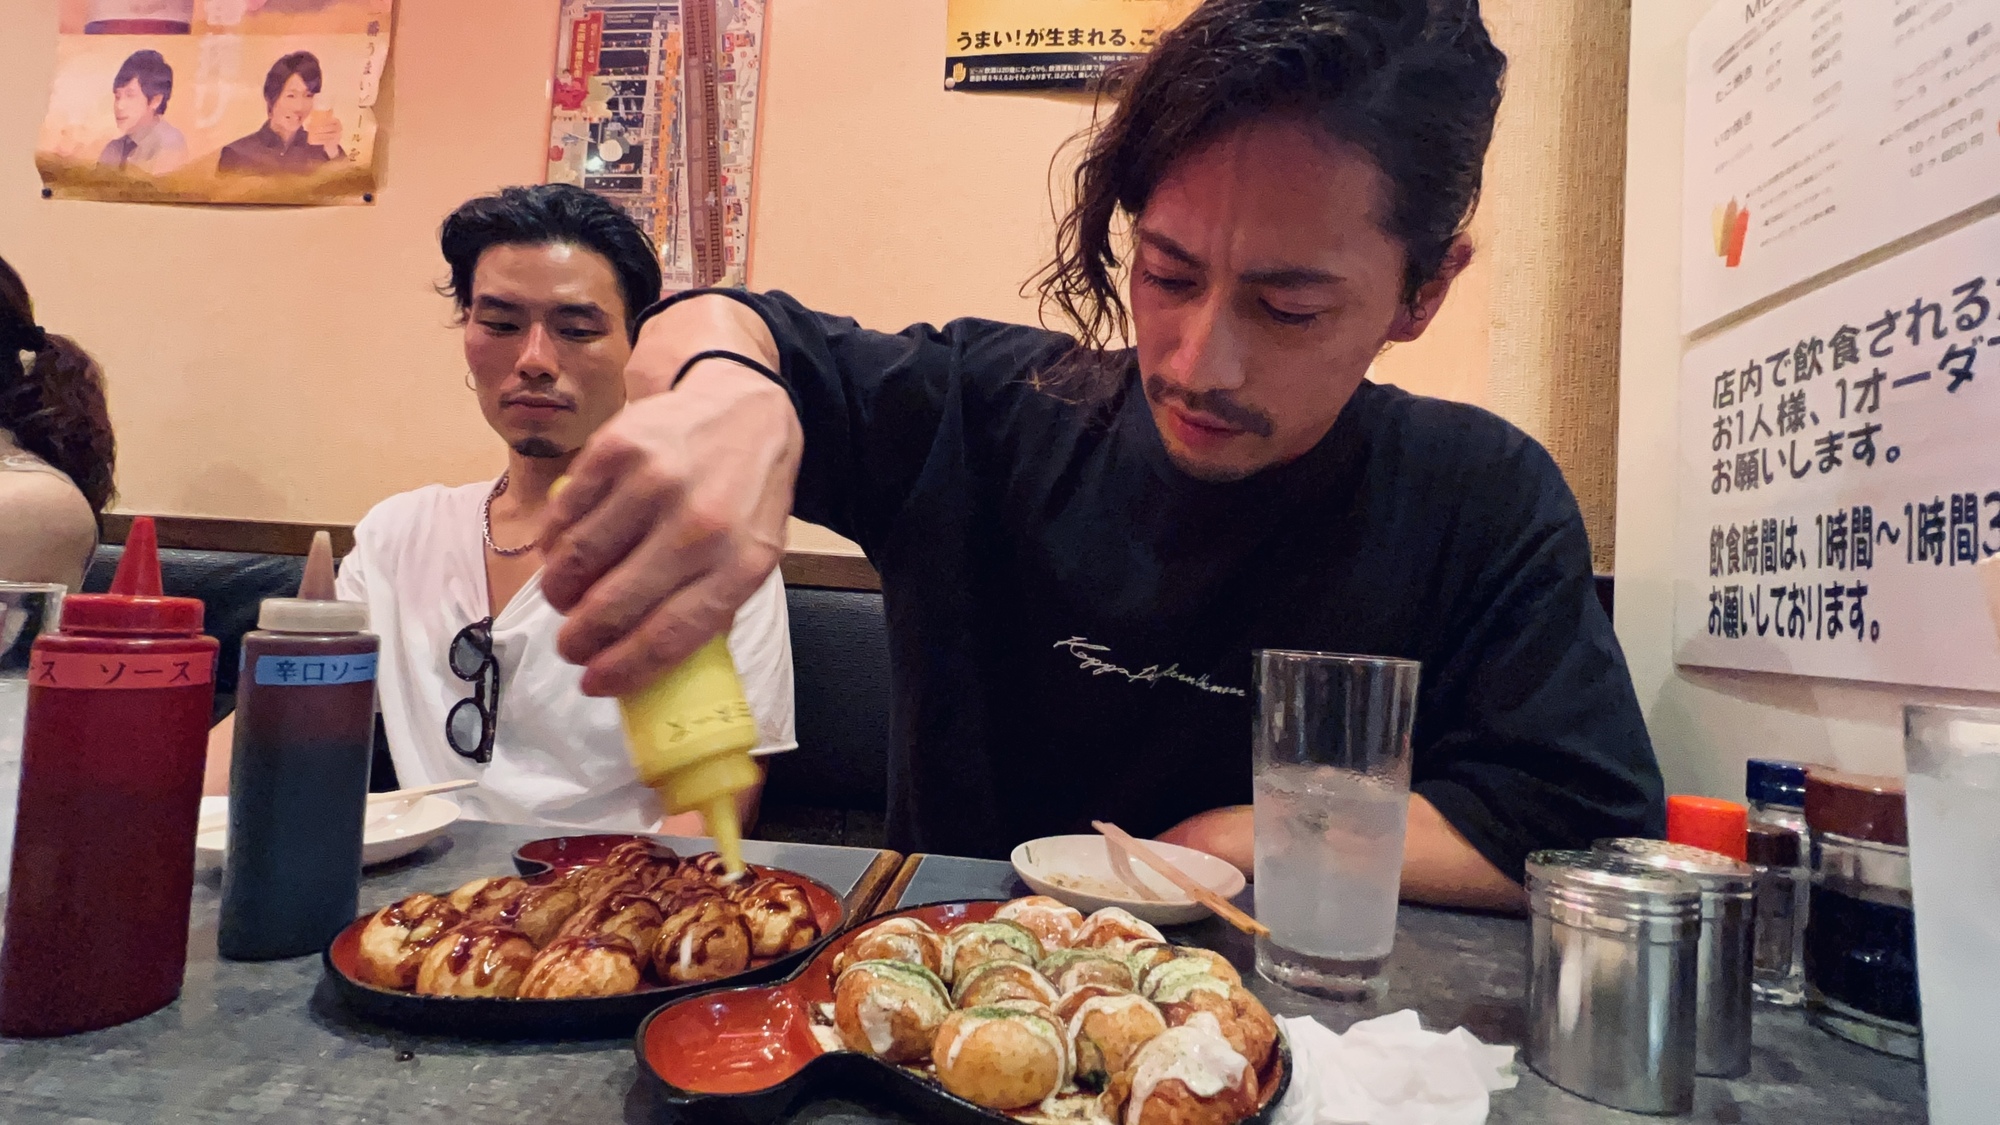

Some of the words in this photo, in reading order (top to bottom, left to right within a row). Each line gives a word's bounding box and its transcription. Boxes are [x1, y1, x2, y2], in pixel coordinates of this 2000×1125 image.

[1712, 276, 2000, 409] 店内で飲食される
[1711, 422, 1901, 494] お願いします。
[1708, 580, 1880, 642] お願いしております。
[100, 660, 191, 685] ソース
[275, 659, 376, 682] 辛口ソー
